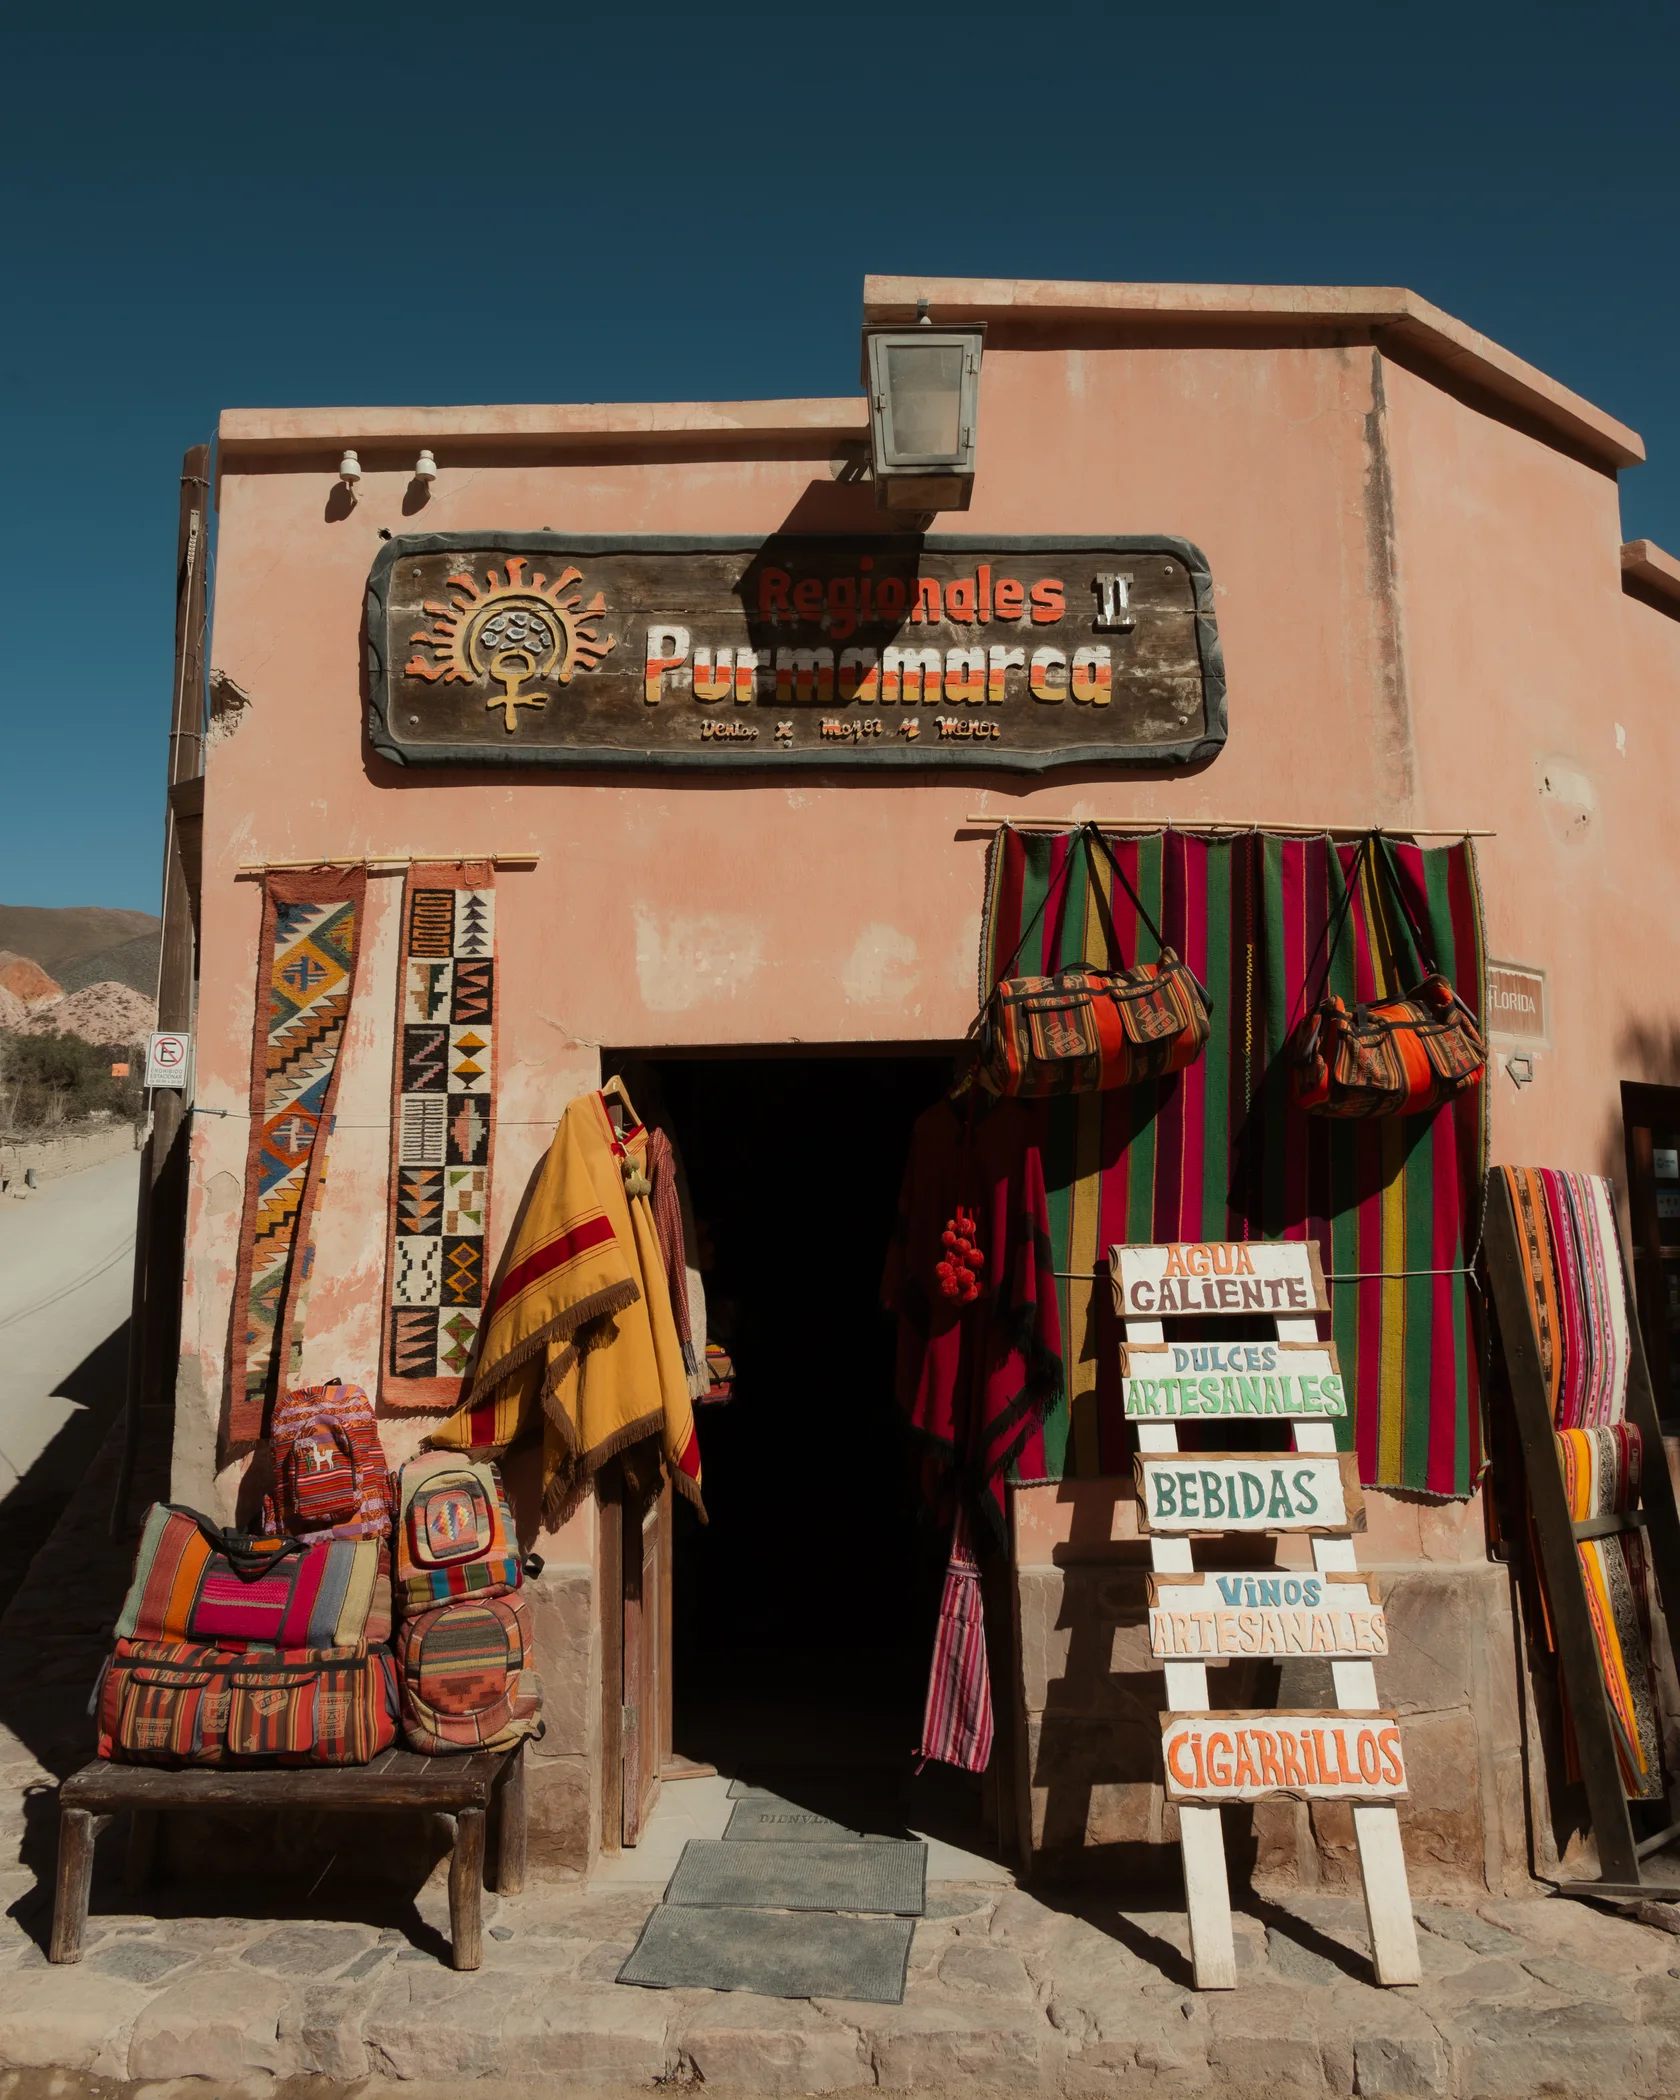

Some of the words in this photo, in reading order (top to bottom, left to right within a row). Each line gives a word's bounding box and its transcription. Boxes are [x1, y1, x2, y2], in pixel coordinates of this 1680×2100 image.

[759, 556, 1066, 640] Regionales
[1096, 572, 1137, 626] II
[644, 625, 1112, 704] Purmamarca
[1488, 984, 1536, 1014] FLORIDA
[1163, 1242, 1256, 1278] AGUA
[1172, 1345, 1278, 1373] DULCES
[1125, 1375, 1346, 1417] ARTESANALES
[1151, 1469, 1319, 1519] BEBIDAS
[1153, 1611, 1389, 1655] ARTESANALES
